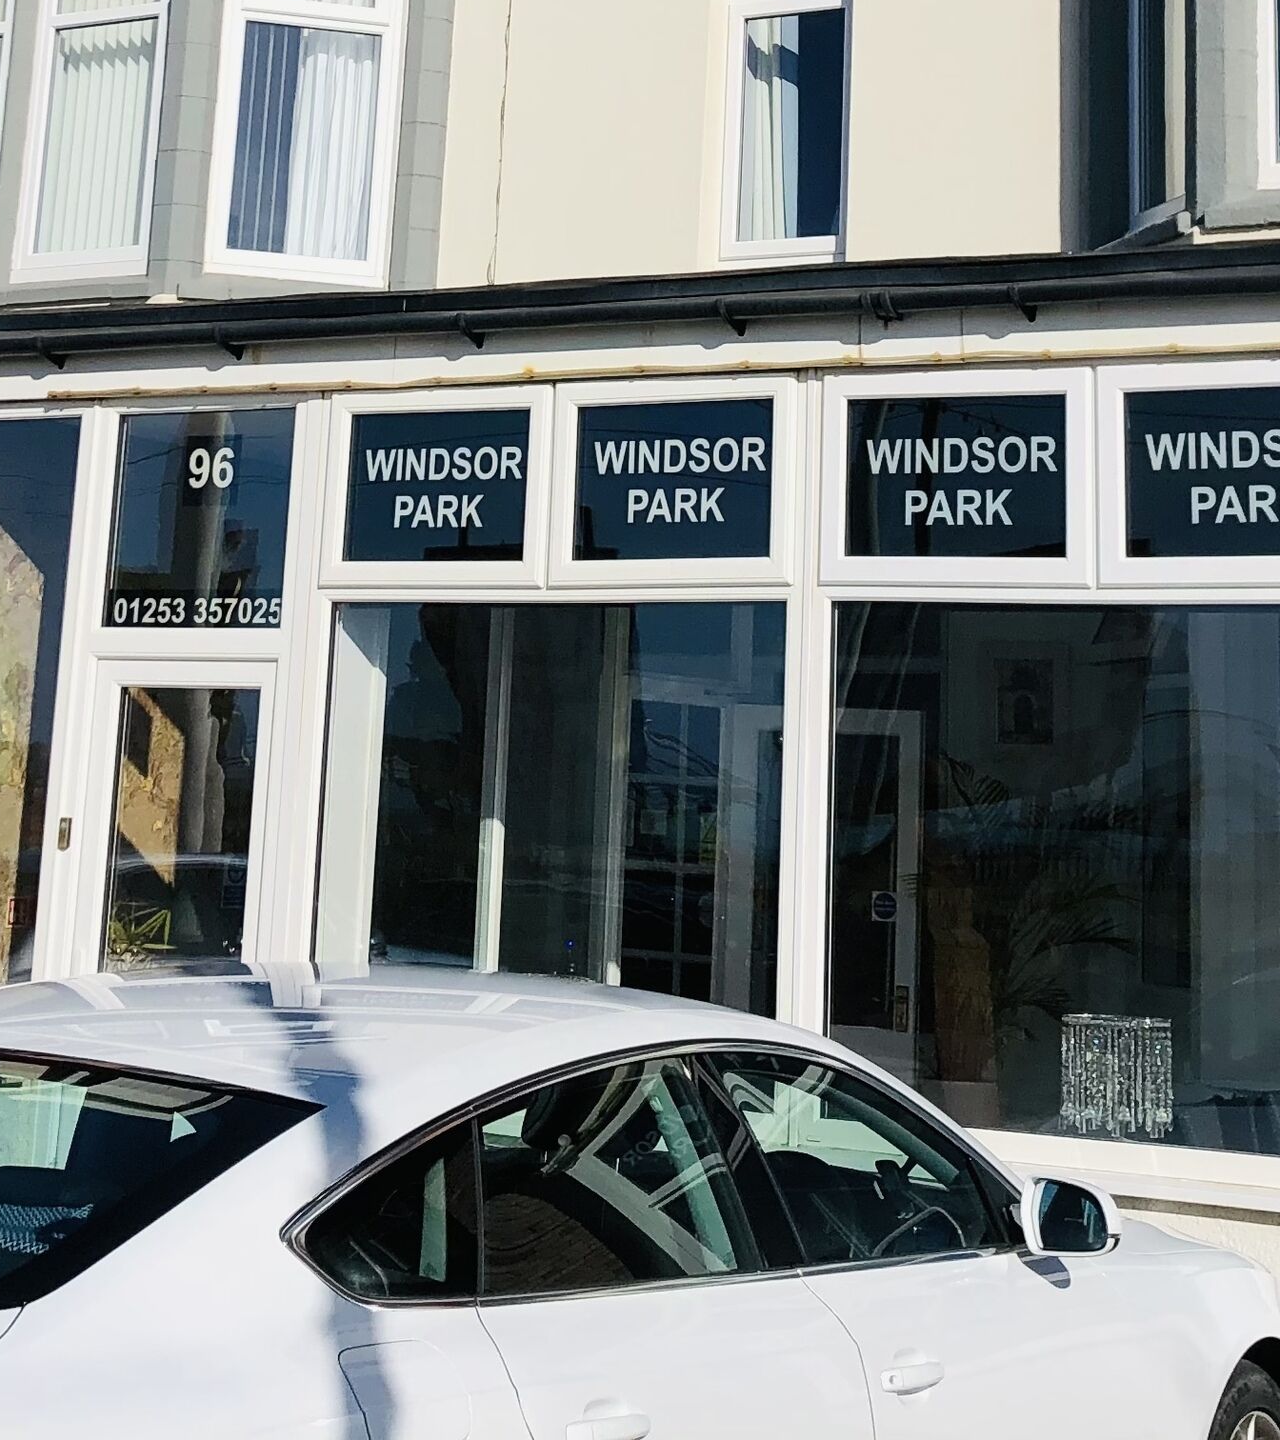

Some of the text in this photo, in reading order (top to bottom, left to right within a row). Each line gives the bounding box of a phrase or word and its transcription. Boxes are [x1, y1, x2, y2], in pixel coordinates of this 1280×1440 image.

[188, 447, 235, 489] 96
[367, 447, 522, 481] WINDSOR
[595, 437, 766, 474] WINDSOR
[867, 436, 1057, 474] WINDSOR
[394, 495, 483, 527] PARK
[628, 488, 724, 523] PARK
[905, 490, 1012, 525] PARK
[114, 597, 281, 624] 01253 357025
